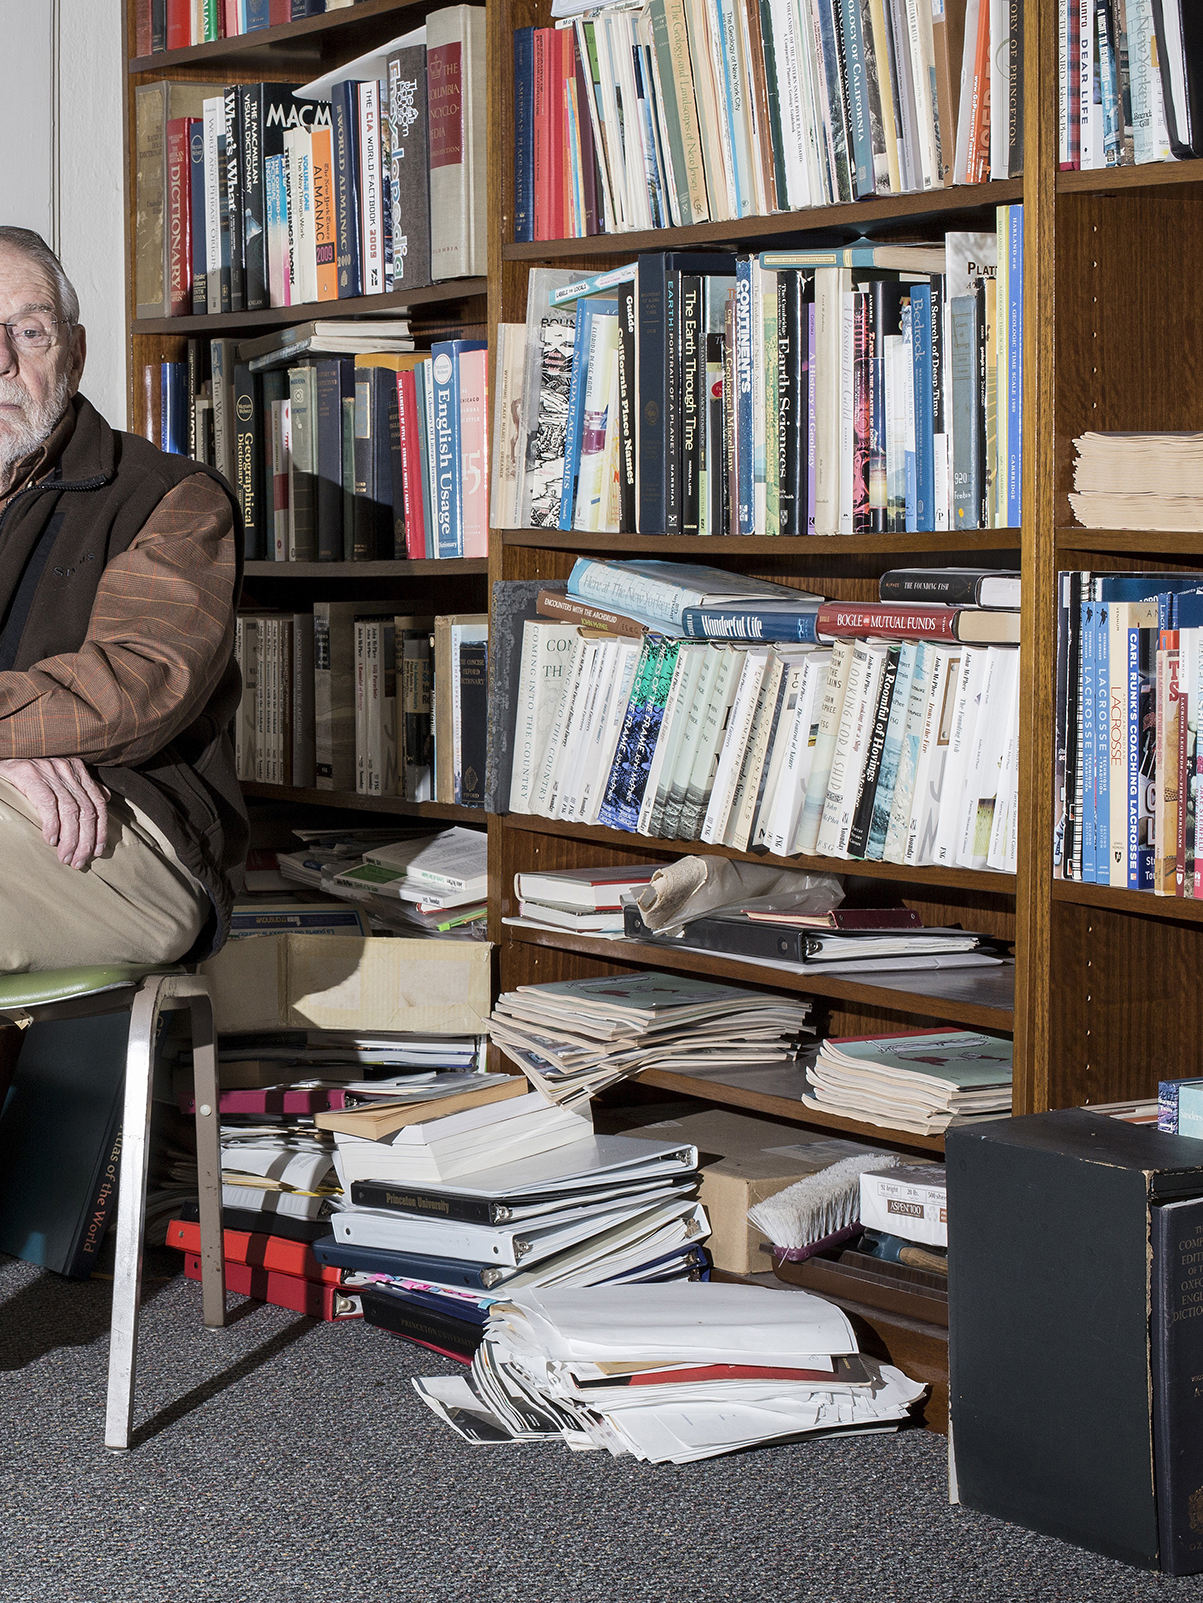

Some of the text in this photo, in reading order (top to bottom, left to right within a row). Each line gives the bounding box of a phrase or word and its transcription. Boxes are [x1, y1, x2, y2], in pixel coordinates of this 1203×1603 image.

[671, 4, 680, 20] The
[672, 21, 685, 61] Geology
[851, 43, 858, 56] OF
[443, 63, 459, 78] THE
[1080, 39, 1088, 84] DEAR
[1136, 17, 1150, 108] New Yorker
[681, 80, 694, 132] Landscapes
[1009, 39, 1018, 146] OF PRINCETON
[224, 91, 238, 212] What's What
[684, 132, 692, 142] of
[245, 130, 253, 194] DICTIONARY
[365, 89, 377, 258] THE CIA WORLD FACTBOOK 2009
[389, 59, 407, 280] Encyclopedia
[688, 164, 699, 192] Jersey
[336, 114, 348, 251] WORLD ALMANAC
[313, 165, 325, 241] ALMANAC
[170, 164, 181, 290] DICTIONARY
[316, 244, 333, 263] 2009
[625, 295, 634, 332] Gudde
[930, 290, 939, 303] In
[741, 278, 750, 394] CONTINENTS
[913, 298, 924, 362] Bedrock
[931, 305, 939, 344] Search
[685, 290, 697, 451] The Earth Through Time
[809, 352, 816, 361] A
[932, 345, 940, 358] of
[569, 350, 580, 403] NEVADA
[669, 386, 675, 401] OF
[566, 403, 576, 445] PLACE
[618, 327, 634, 485] California Place Names
[670, 403, 675, 411] A
[778, 335, 790, 478] Earth Sciences
[438, 389, 453, 535] English Usage
[809, 422, 817, 469] Geology
[244, 431, 255, 528] Geographical
[461, 449, 481, 495] 15
[562, 445, 573, 490] NAMES
[954, 471, 968, 486] 920
[561, 497, 569, 520] Nevada
[583, 574, 673, 615] Here at The New Yorker
[903, 581, 949, 591] THE FOUNDING FISH
[544, 598, 571, 612] ENCOUNTERS
[571, 604, 583, 614] WITH
[591, 609, 617, 623] ARCHDRUID
[701, 614, 763, 639] Wonderful Life
[837, 612, 936, 631] BOGLE MUTUAL FUNDS
[530, 625, 539, 678] COMING
[654, 643, 667, 677] PIECES
[651, 677, 660, 692] OF
[843, 660, 862, 719] LOOKING
[645, 695, 656, 715] THE
[866, 660, 896, 783] A Roomful of Hovings
[1083, 666, 1092, 749] LACROSSE
[1098, 669, 1107, 752] LACROSSE
[636, 715, 652, 752] FRAME
[838, 721, 851, 746] FOR
[1111, 686, 1122, 766] LACROSSE
[520, 742, 531, 800] COUNTRY
[632, 752, 642, 771] John
[1129, 633, 1138, 870] CARL RUNK'S COACHING LACROSSE
[830, 758, 845, 790] SHIP
[106, 1165, 116, 1183] of
[886, 1184, 899, 1194] bright
[96, 1183, 113, 1206] the
[385, 1192, 450, 1214] Princeton University
[890, 1201, 922, 1215] ASPEN 100
[83, 1210, 106, 1253] World
[1178, 1236, 1203, 1251] COMP
[1181, 1251, 1203, 1266] EDIT
[400, 1318, 476, 1350] PRINCETON UNIVERSITY
